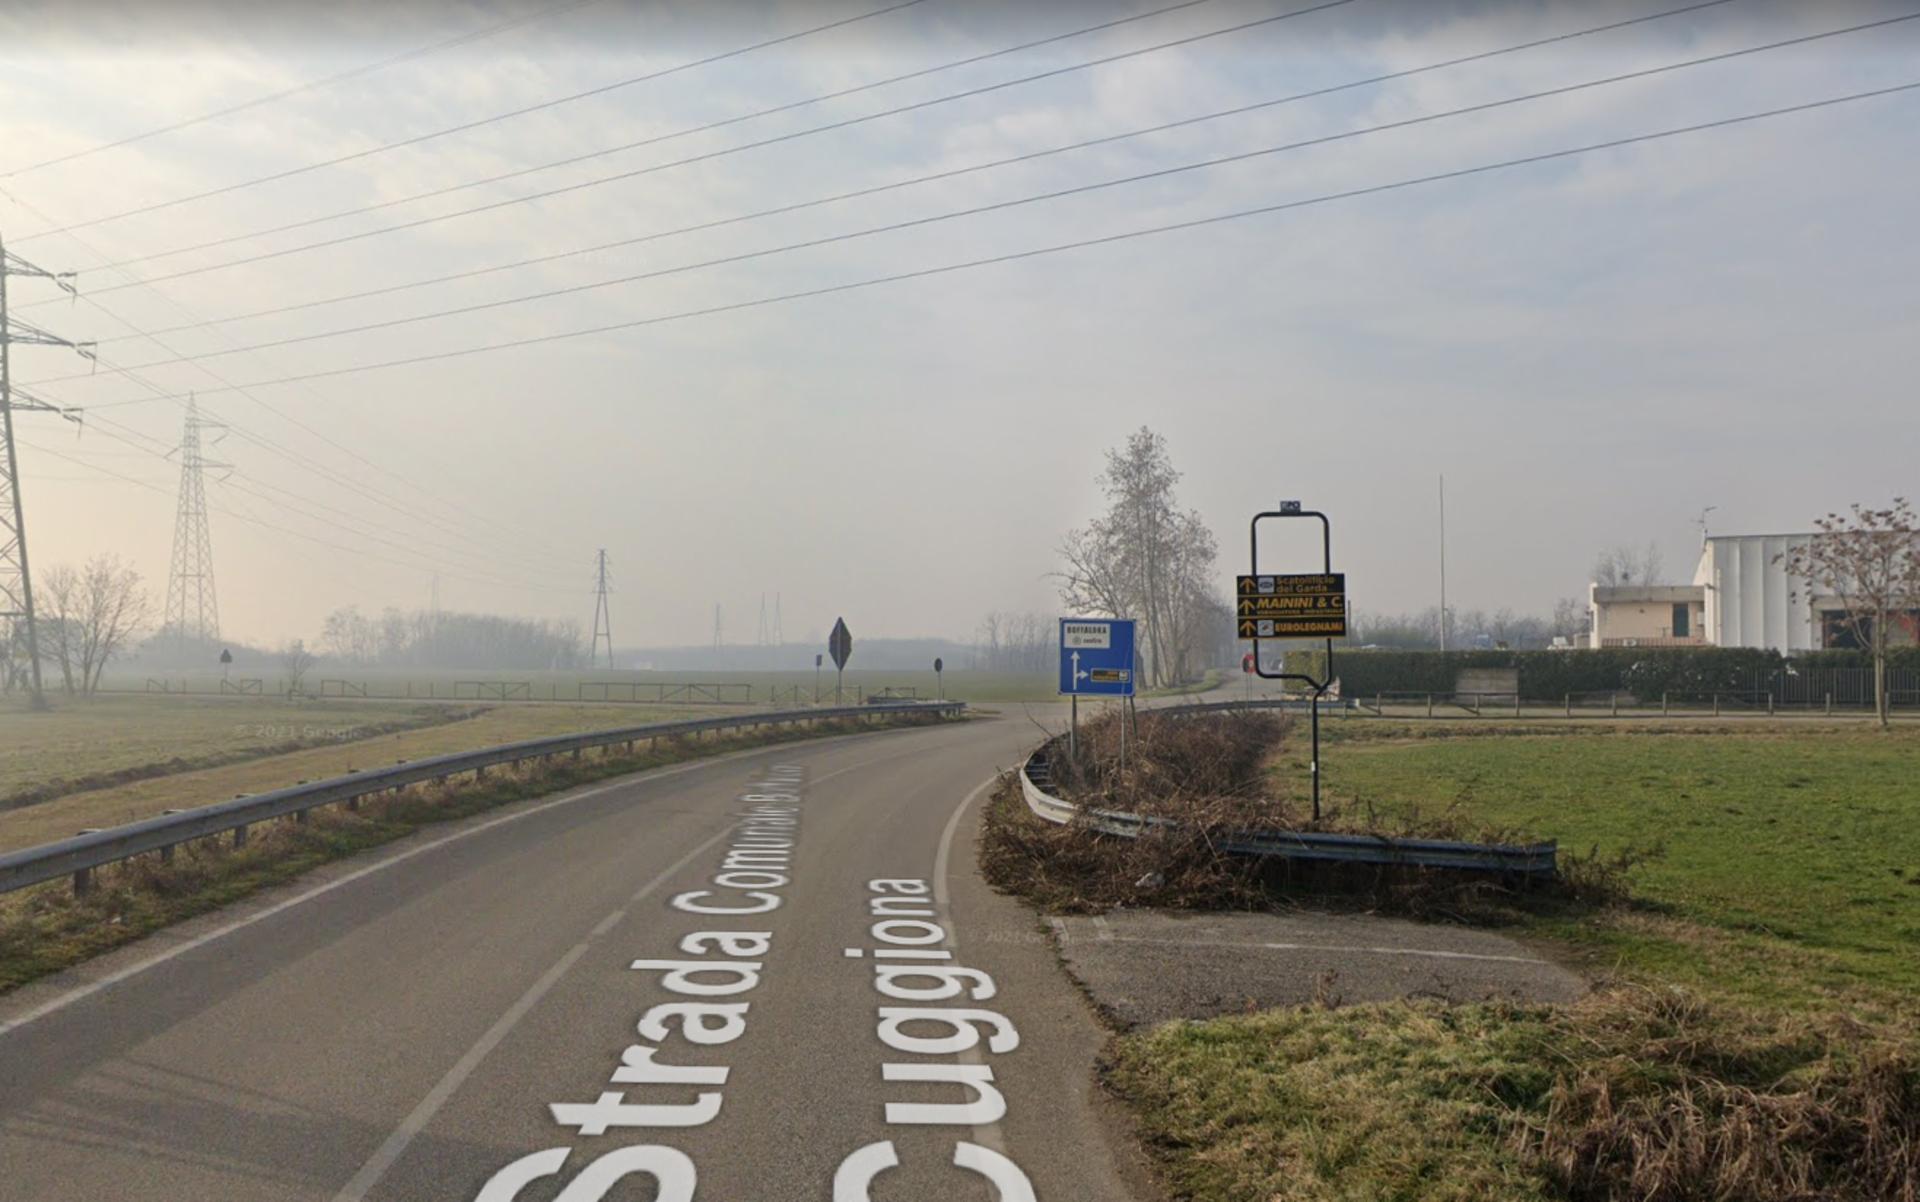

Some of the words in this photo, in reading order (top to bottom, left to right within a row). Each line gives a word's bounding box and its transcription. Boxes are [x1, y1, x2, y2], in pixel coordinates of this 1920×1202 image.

[1276, 585, 1293, 593] del
[1295, 584, 1328, 593] Garda
[1257, 597, 1313, 609] MAININI
[1317, 596, 1327, 608] &
